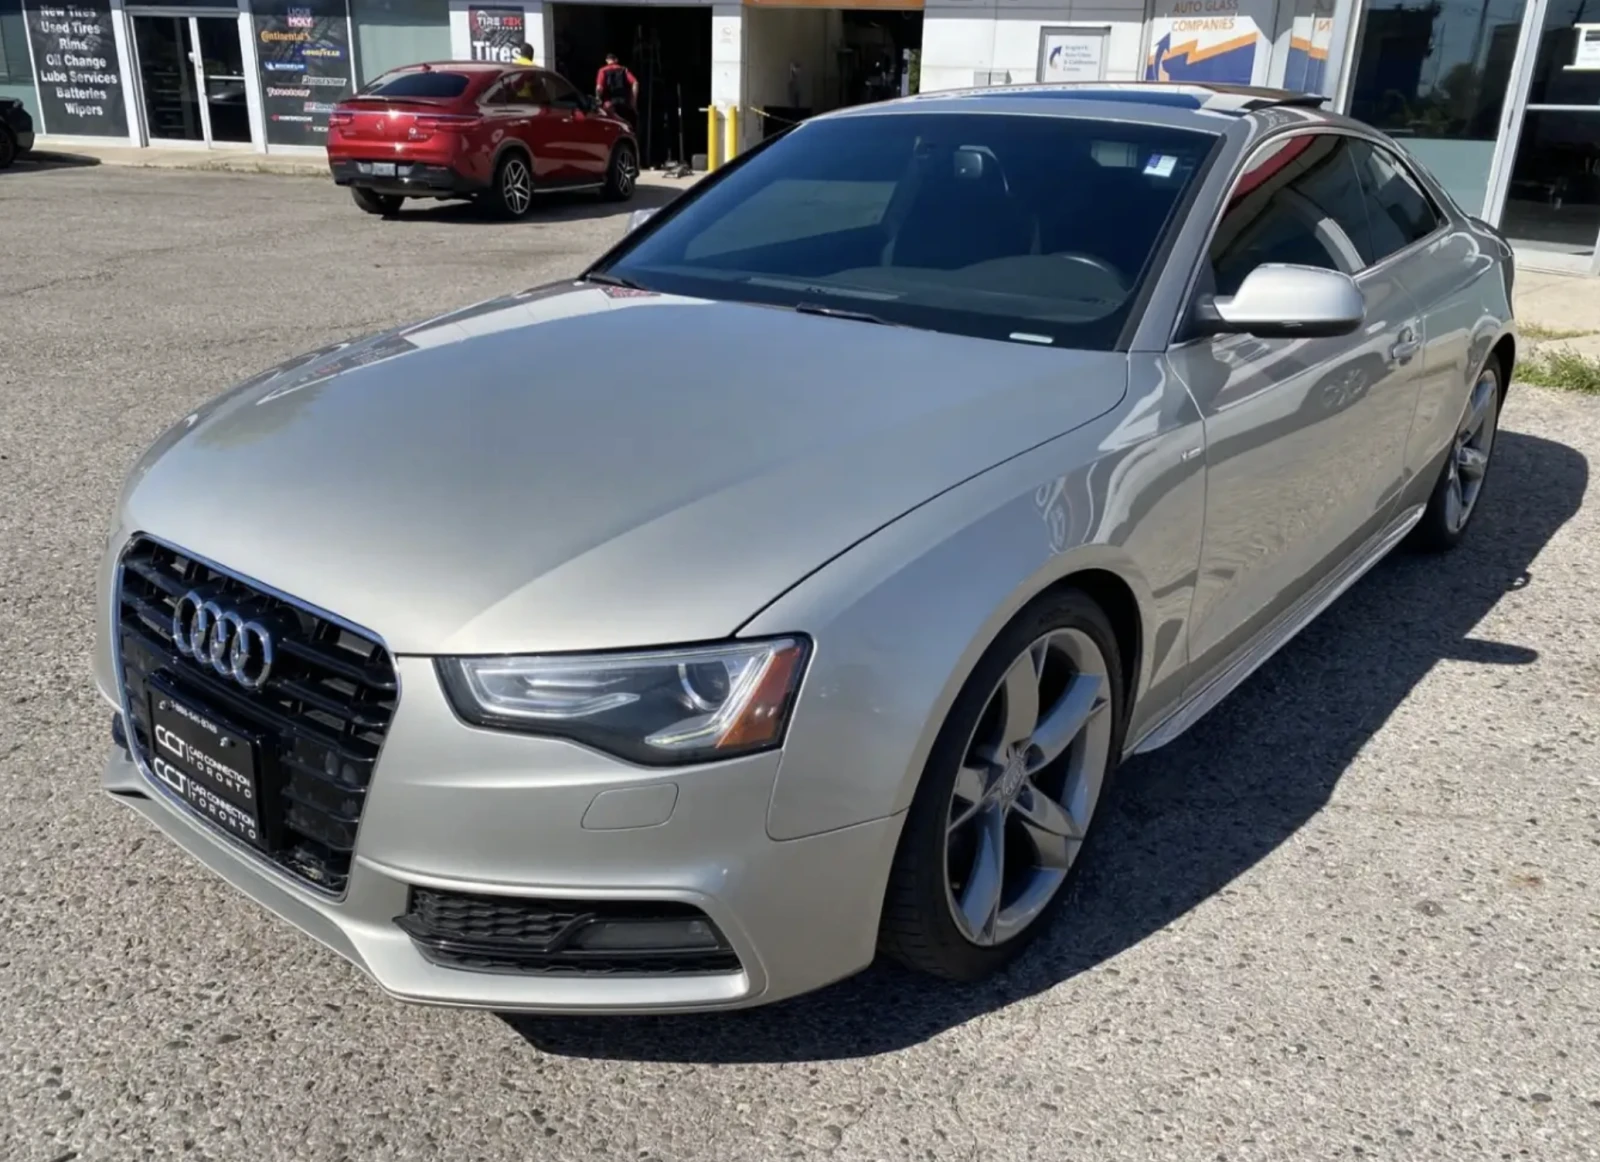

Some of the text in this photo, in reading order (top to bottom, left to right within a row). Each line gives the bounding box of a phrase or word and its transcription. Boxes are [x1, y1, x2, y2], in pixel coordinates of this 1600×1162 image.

[40, 5, 97, 17] New Tires
[1172, 0, 1239, 13] AUTO GLASS
[41, 21, 101, 34] Used Tires
[288, 17, 313, 27] MOLY
[477, 16, 500, 27] TIRE
[1171, 18, 1234, 32] COMPANIES
[59, 37, 88, 50] Rims
[473, 41, 522, 62] Tires
[46, 54, 107, 70] Oil Change
[41, 70, 118, 84] Lube Services
[56, 87, 107, 99] Batteries
[65, 103, 104, 117] Wipers
[188, 745, 252, 788] CAR CONNECTION
[189, 756, 253, 798] TORONTO
[190, 780, 256, 829] CAR CONNECTION
[191, 791, 257, 838] TORONTO
